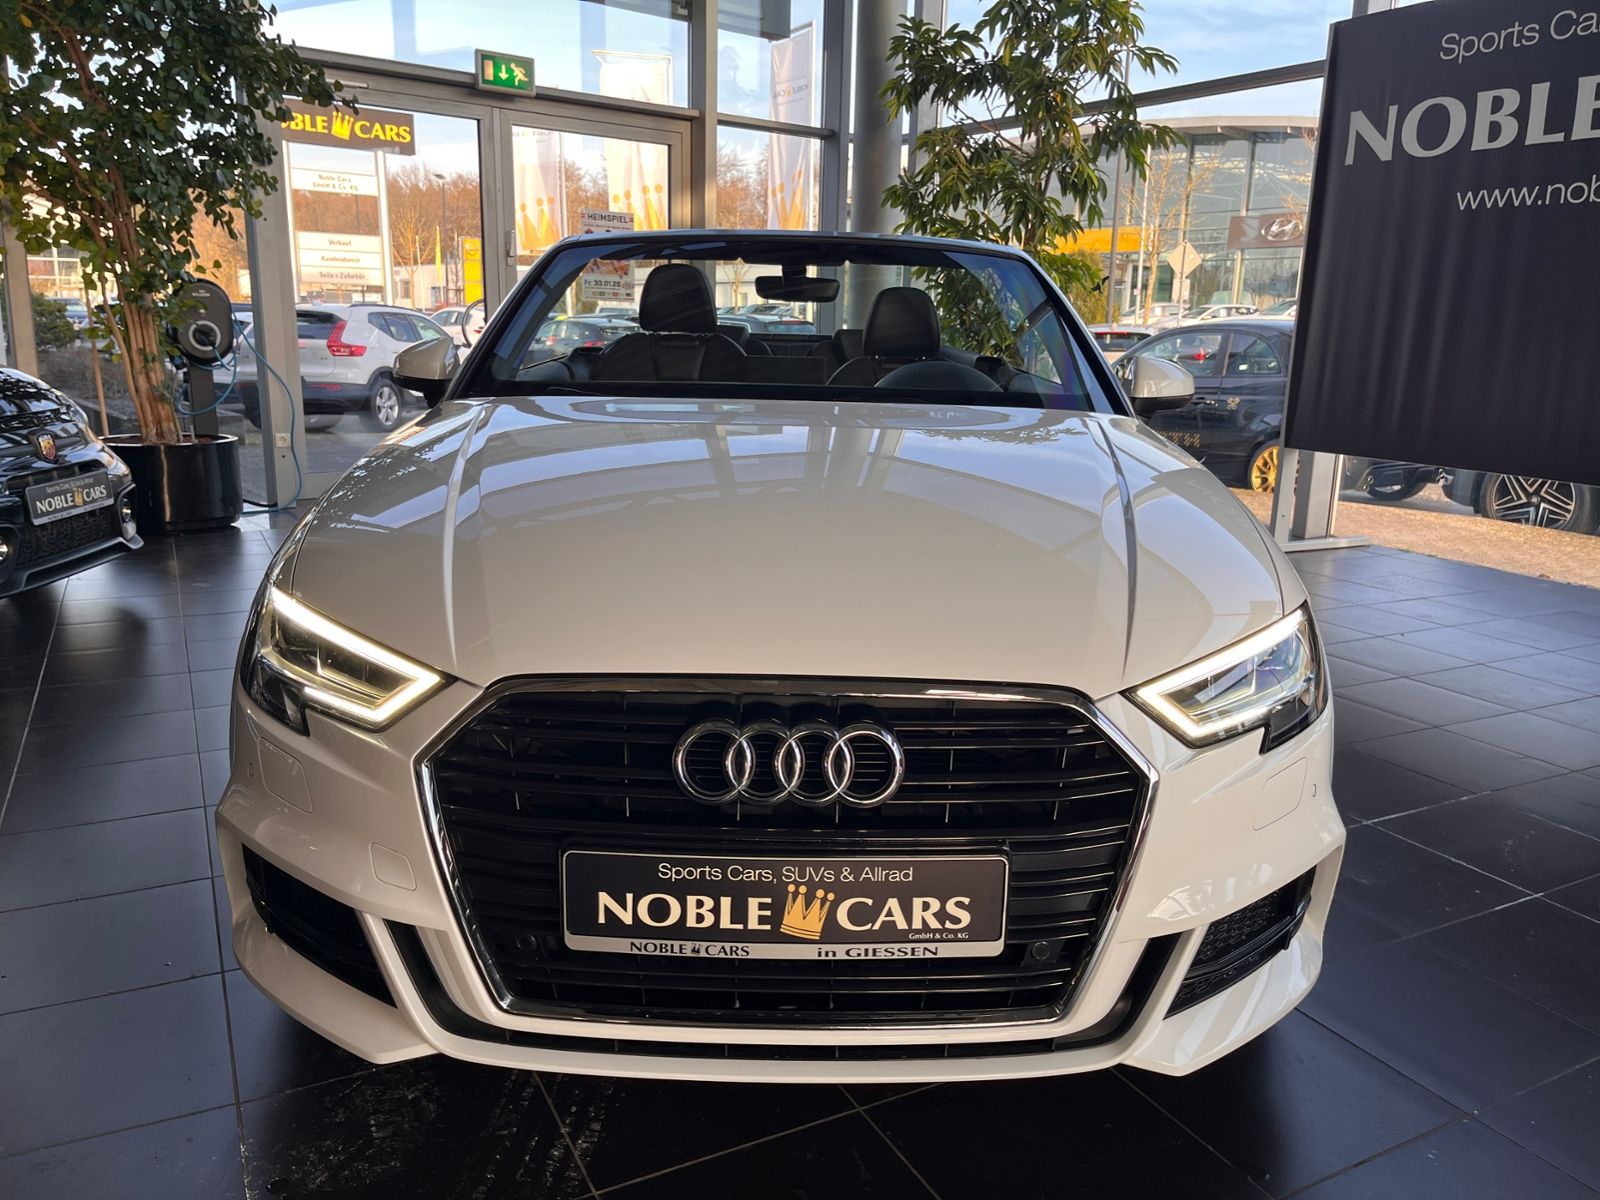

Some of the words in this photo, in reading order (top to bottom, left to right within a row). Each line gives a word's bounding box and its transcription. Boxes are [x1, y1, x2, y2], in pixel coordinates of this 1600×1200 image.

[1439, 21, 1540, 64] Sports
[1550, 9, 1600, 40] Ca
[1344, 74, 1600, 166] NOBLE
[354, 121, 412, 143] CARS
[587, 213, 629, 223] HEIMSPIEL
[36, 493, 74, 514] NOBLE
[83, 485, 107, 502] CARS
[658, 862, 722, 882] Sports
[727, 865, 777, 884] Cars,
[781, 866, 835, 882] SUVs
[840, 867, 855, 882] &
[859, 866, 913, 882] Allrad
[597, 891, 772, 930] NOBLE
[836, 896, 972, 931] CARS
[909, 932, 934, 940] GmbH
[630, 942, 687, 955] NOBLE
[705, 944, 750, 957] CARS
[817, 947, 837, 958] in
[845, 947, 939, 958] GIESSEN
